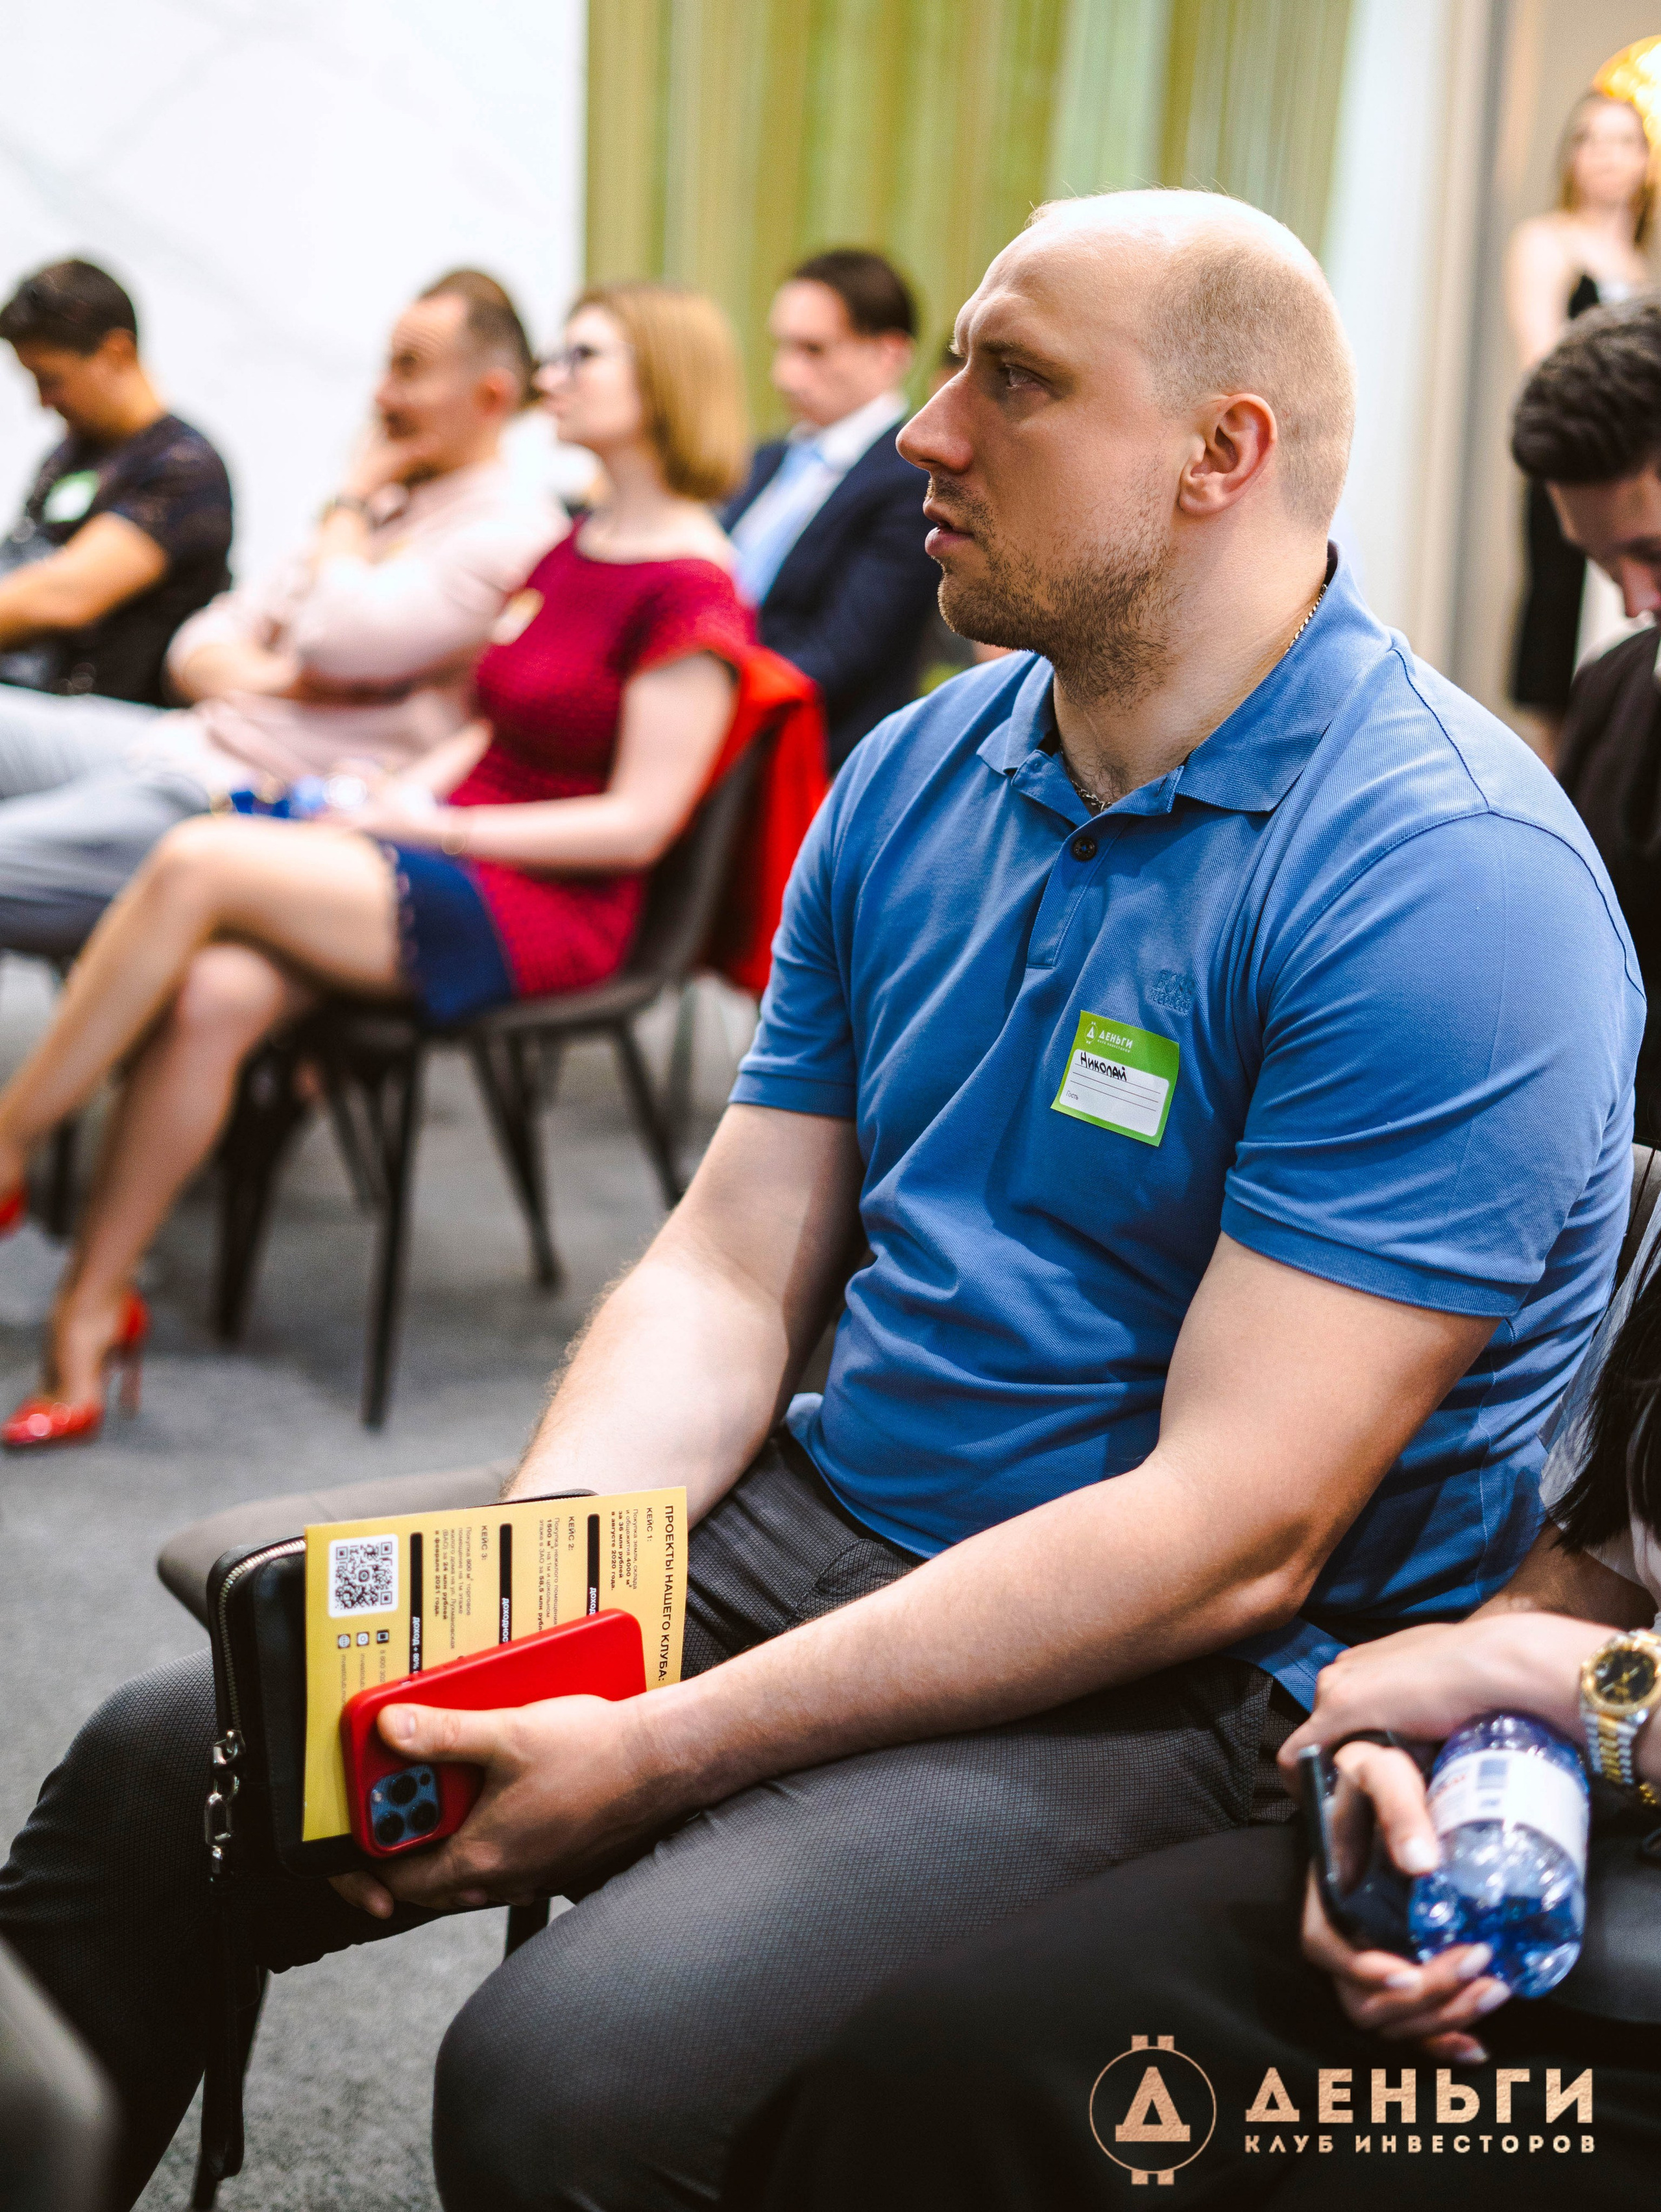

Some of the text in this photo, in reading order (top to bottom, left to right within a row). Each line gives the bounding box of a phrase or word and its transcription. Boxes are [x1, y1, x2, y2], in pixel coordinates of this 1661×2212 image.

[1098, 1030, 1133, 1048] ДЕНЬГИ
[619, 1511, 623, 1519] за
[619, 1522, 623, 1531] 36
[547, 1563, 552, 1571] 1м
[459, 1570, 463, 1579] на
[451, 1576, 455, 1585] на
[659, 1506, 673, 1681] ПРОЕКТЫ НАШЕГО КЛУБА:
